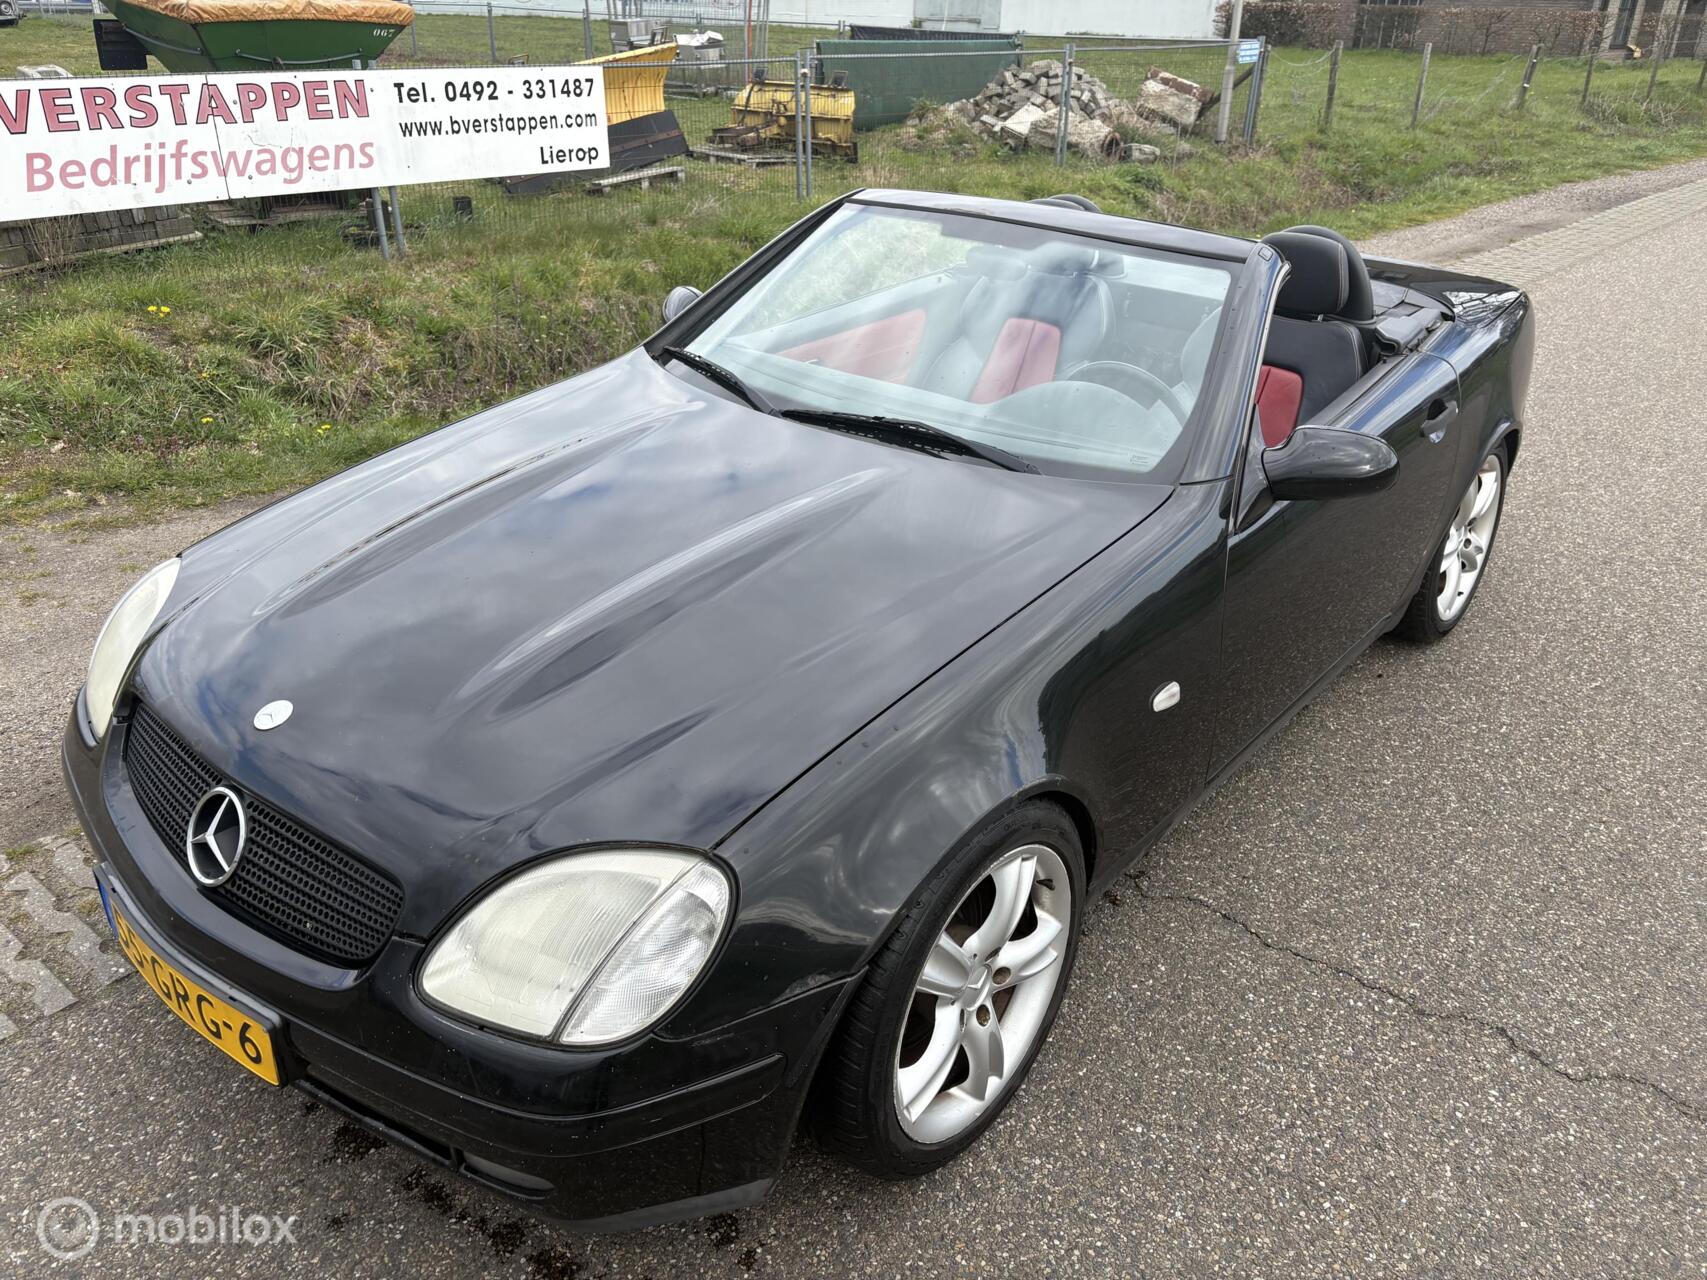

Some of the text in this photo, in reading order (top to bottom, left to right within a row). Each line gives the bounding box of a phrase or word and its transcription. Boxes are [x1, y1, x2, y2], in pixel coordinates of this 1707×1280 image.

[373, 29, 395, 37] 067
[393, 82, 435, 103] Tel.
[444, 80, 499, 102] 0492
[522, 78, 594, 99] 331487
[0, 80, 369, 134] VERSTAPPEN
[398, 113, 598, 137] www.bverstappen.com
[26, 139, 374, 193] Bedrijfswagens
[540, 145, 599, 165] Lierop
